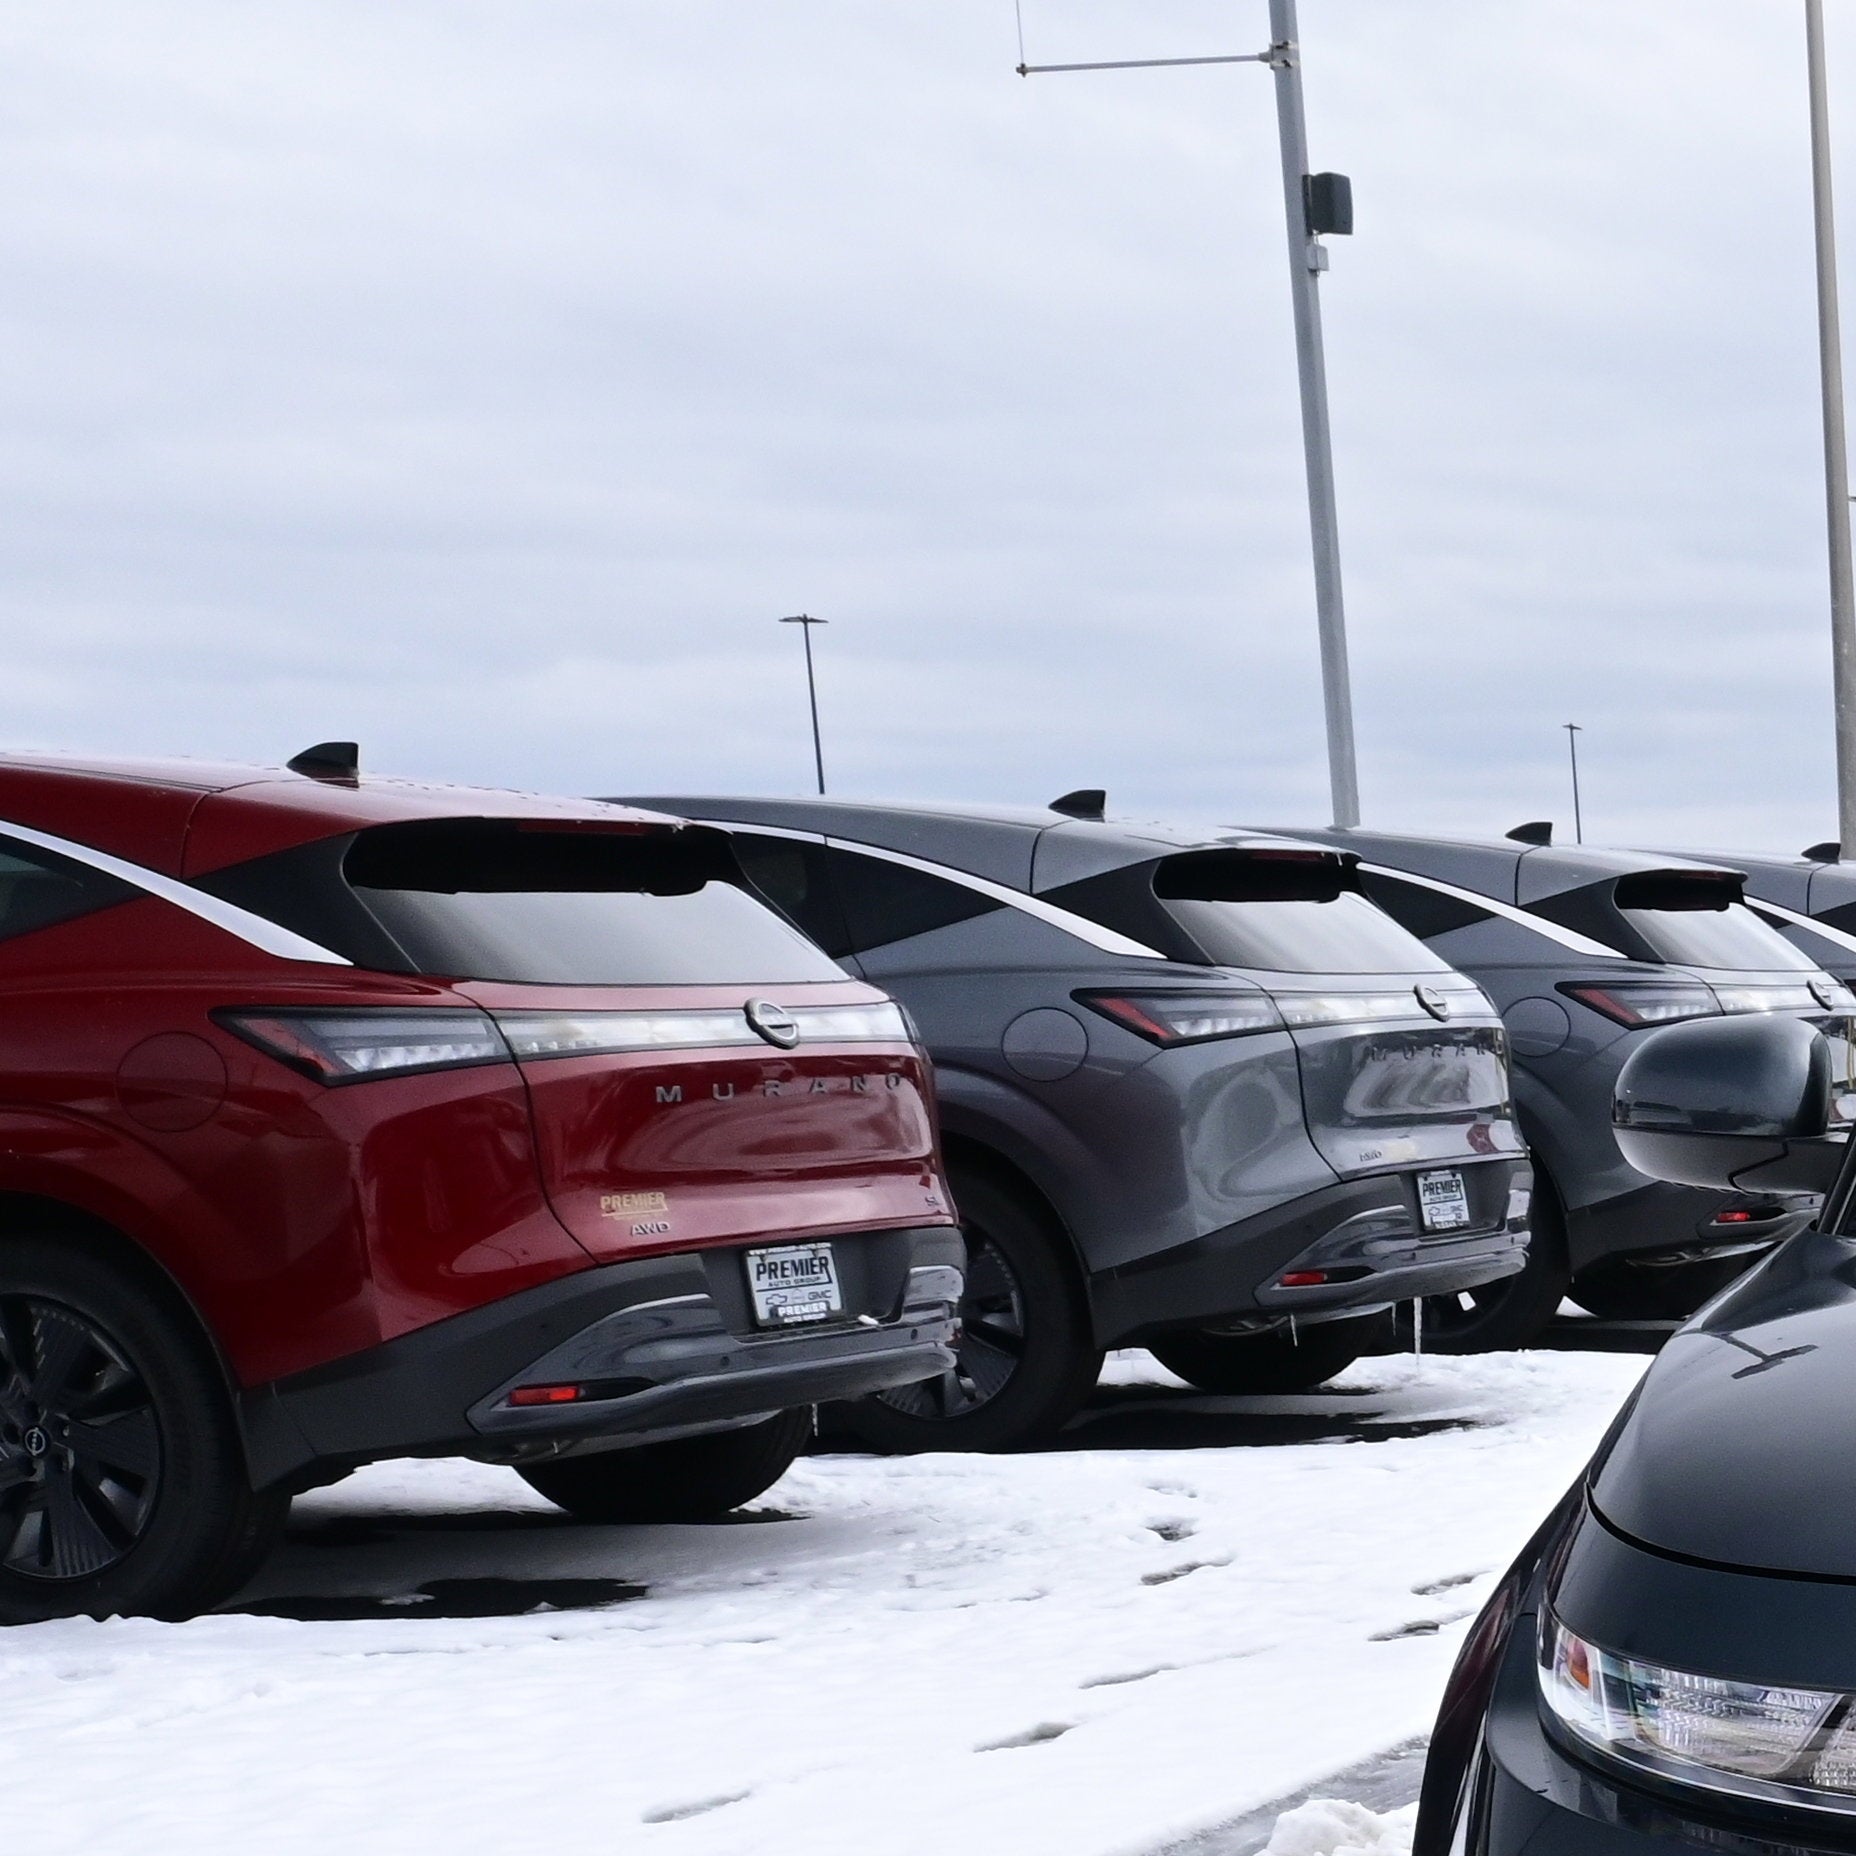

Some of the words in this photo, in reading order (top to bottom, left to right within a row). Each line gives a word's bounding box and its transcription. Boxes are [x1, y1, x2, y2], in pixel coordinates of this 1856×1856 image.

[655, 1072, 901, 1103] MURANO
[601, 1192, 667, 1211] PREMIER
[631, 1221, 671, 1237] AWD
[756, 1256, 832, 1283] PREMIER
[808, 1290, 832, 1301] GMC
[778, 1301, 827, 1318] PREMIER
